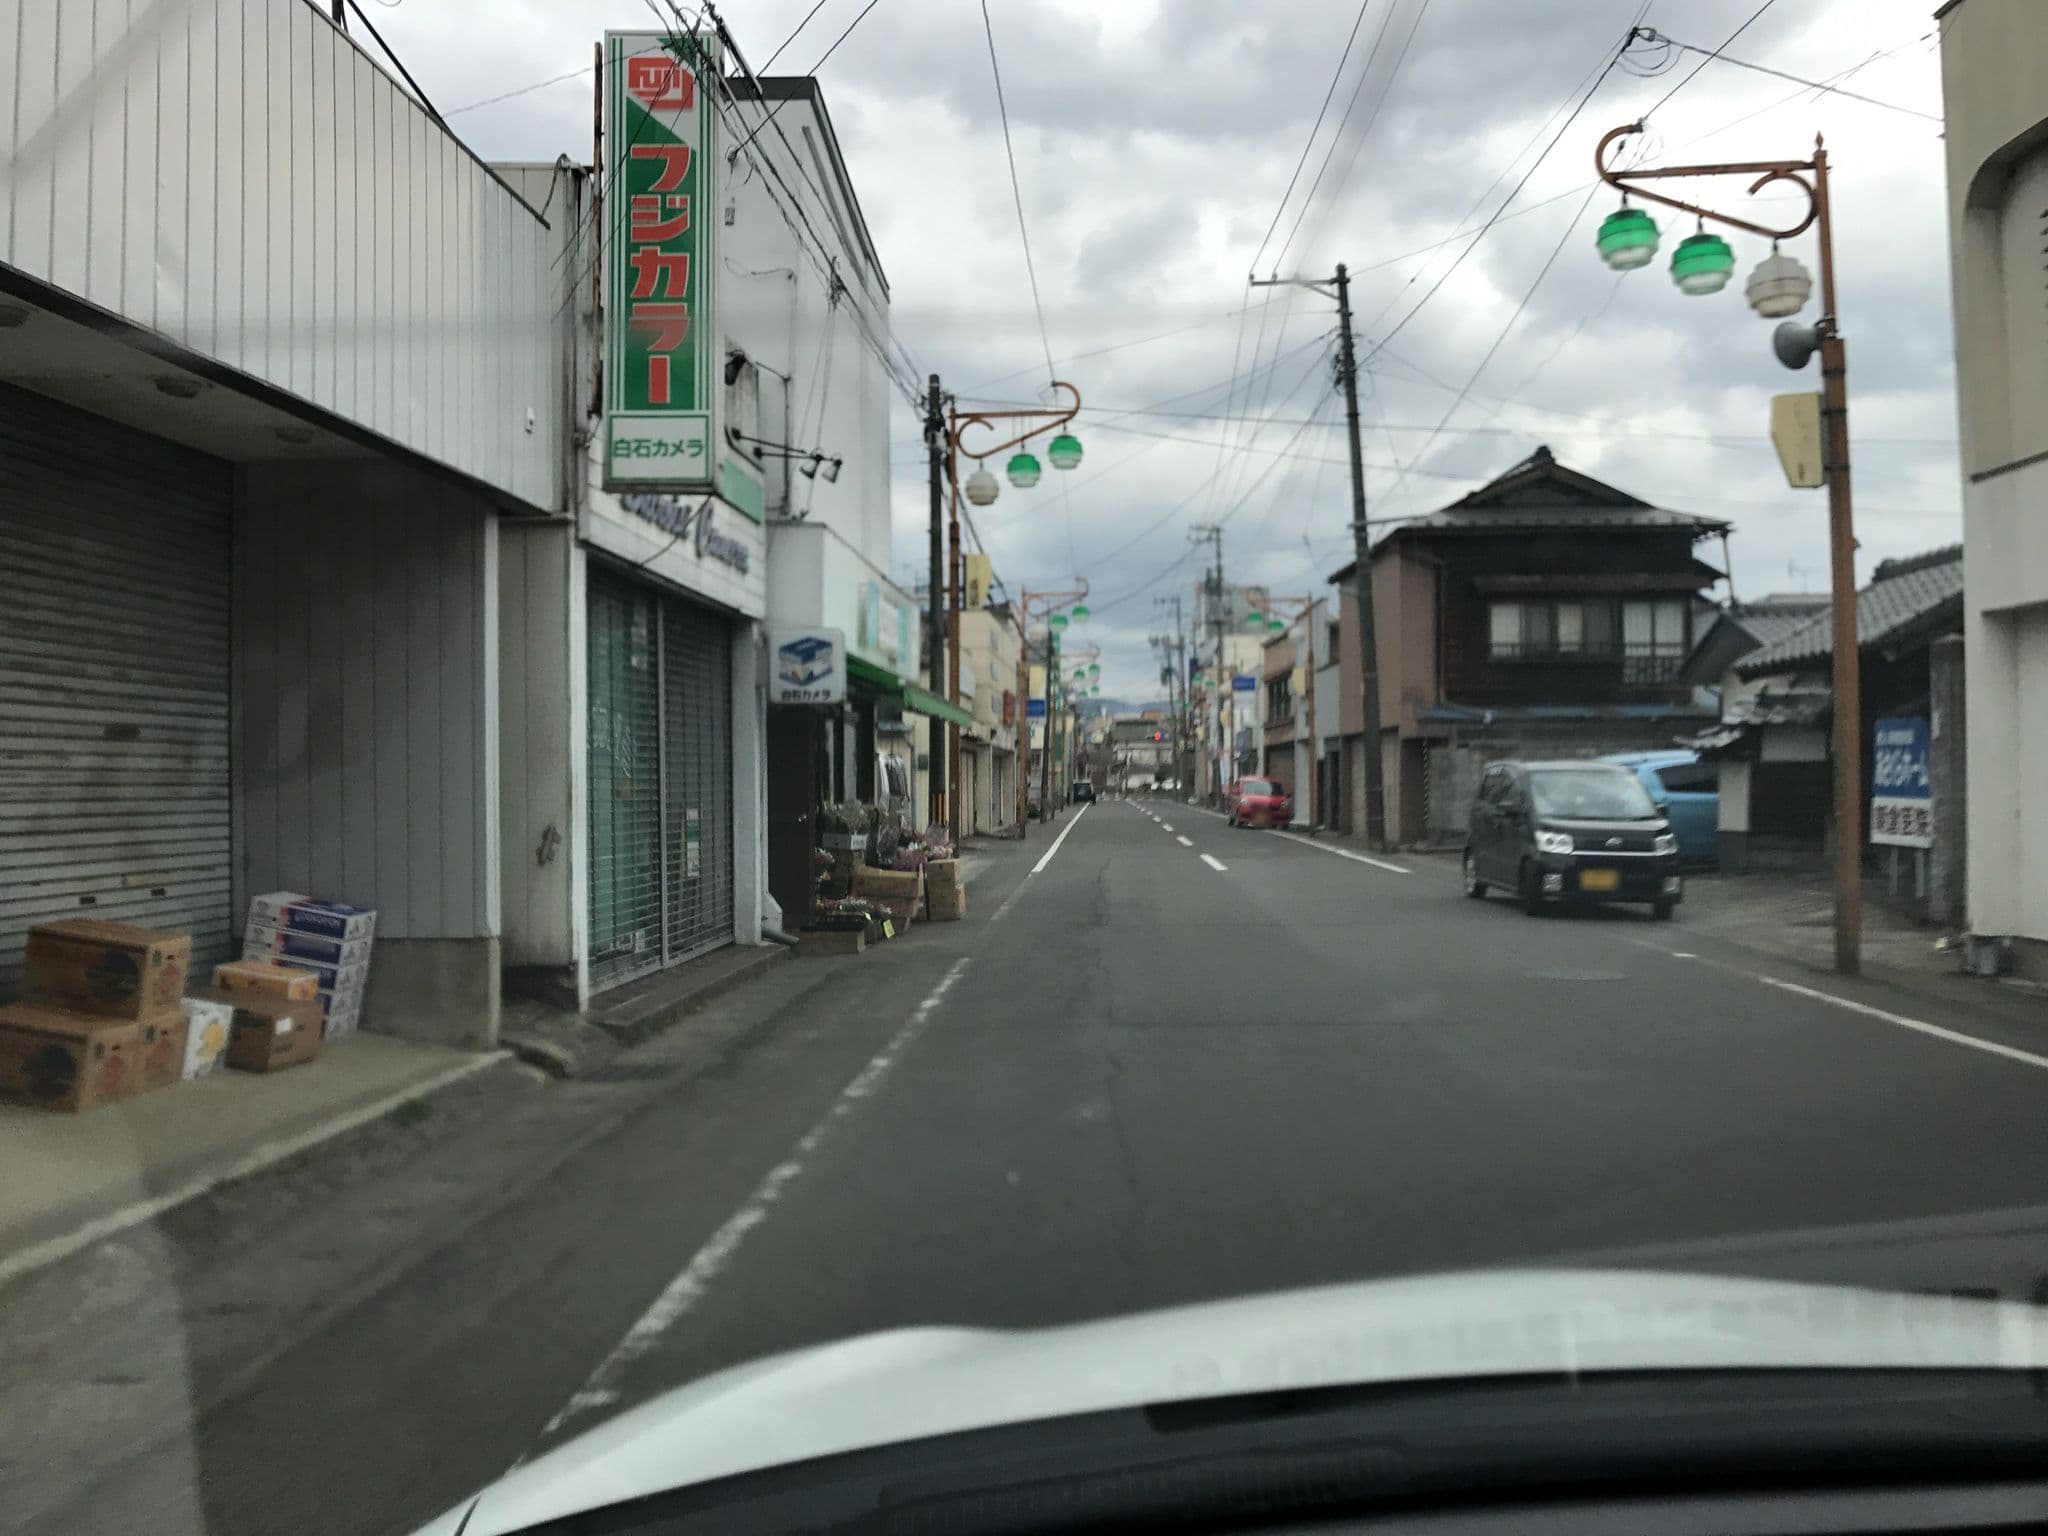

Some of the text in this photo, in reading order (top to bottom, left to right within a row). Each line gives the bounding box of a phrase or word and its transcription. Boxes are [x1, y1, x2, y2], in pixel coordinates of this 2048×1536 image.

[629, 144, 691, 404] フジカラー
[614, 438, 705, 459] 白石カメラ
